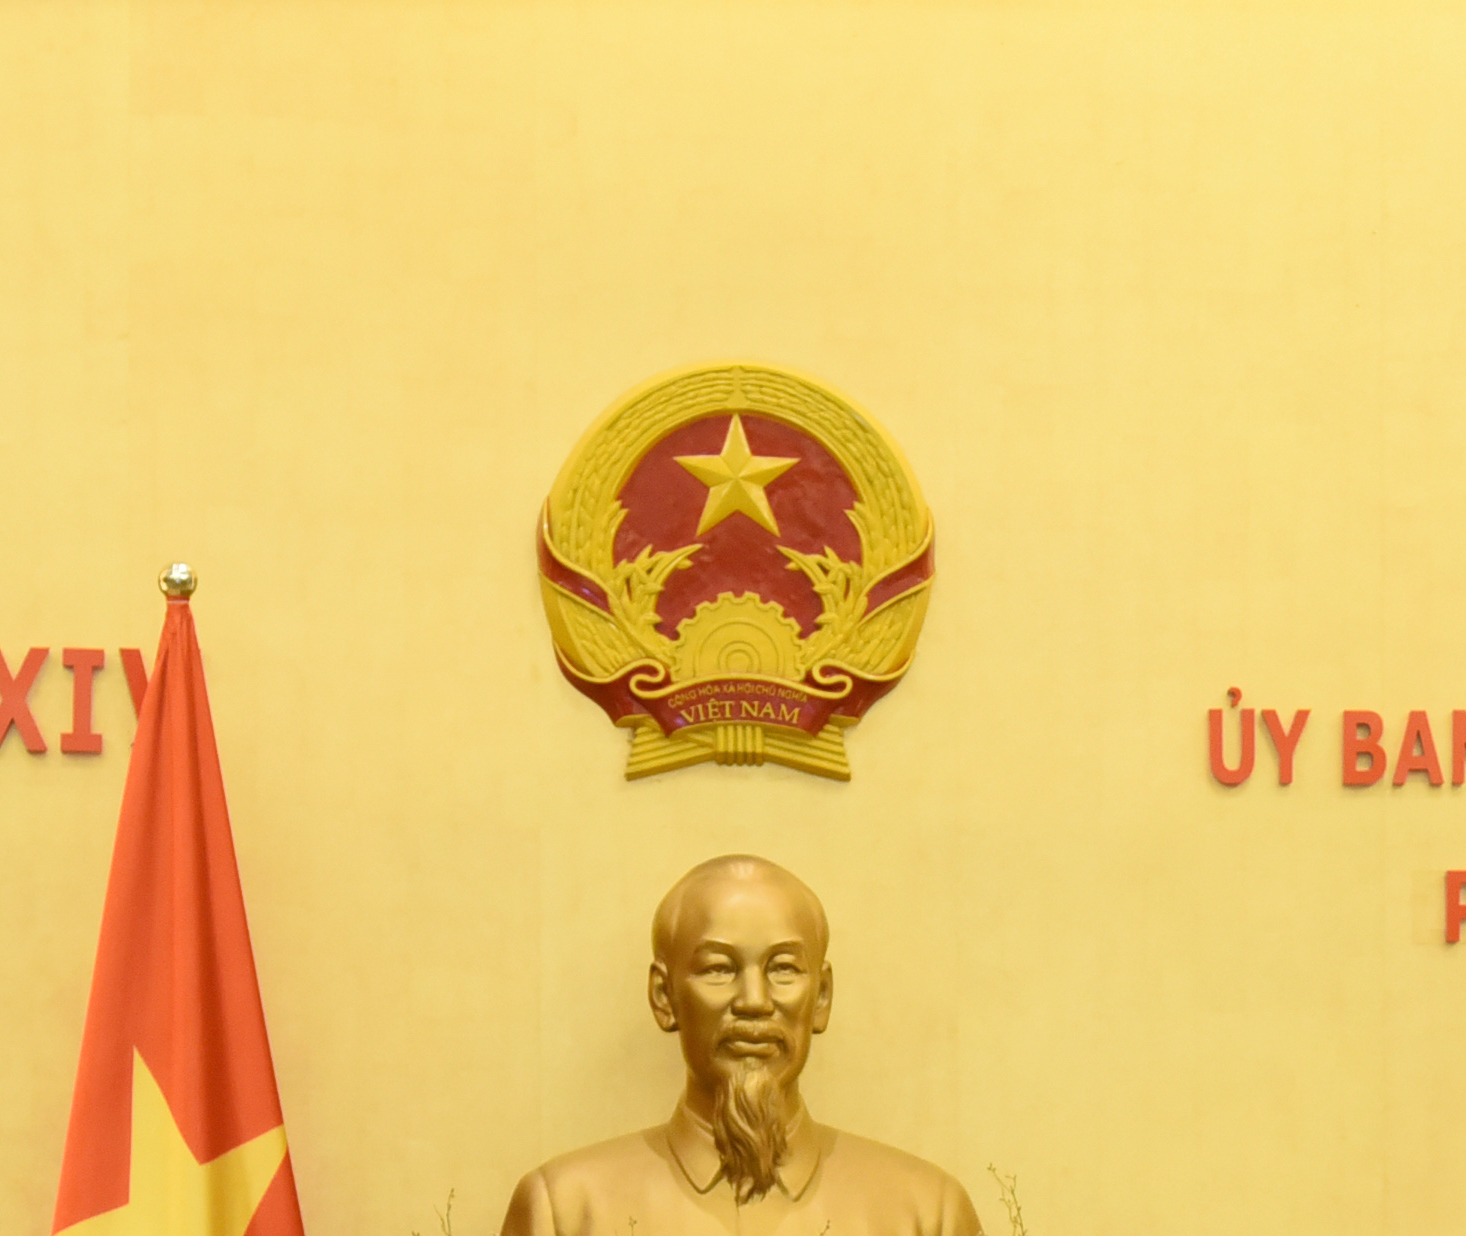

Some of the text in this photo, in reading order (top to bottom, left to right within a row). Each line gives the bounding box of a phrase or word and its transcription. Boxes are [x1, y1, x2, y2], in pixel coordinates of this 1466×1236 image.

[679, 698, 801, 724] VIỆT NAM
[1207, 687, 1311, 787] ỦY
